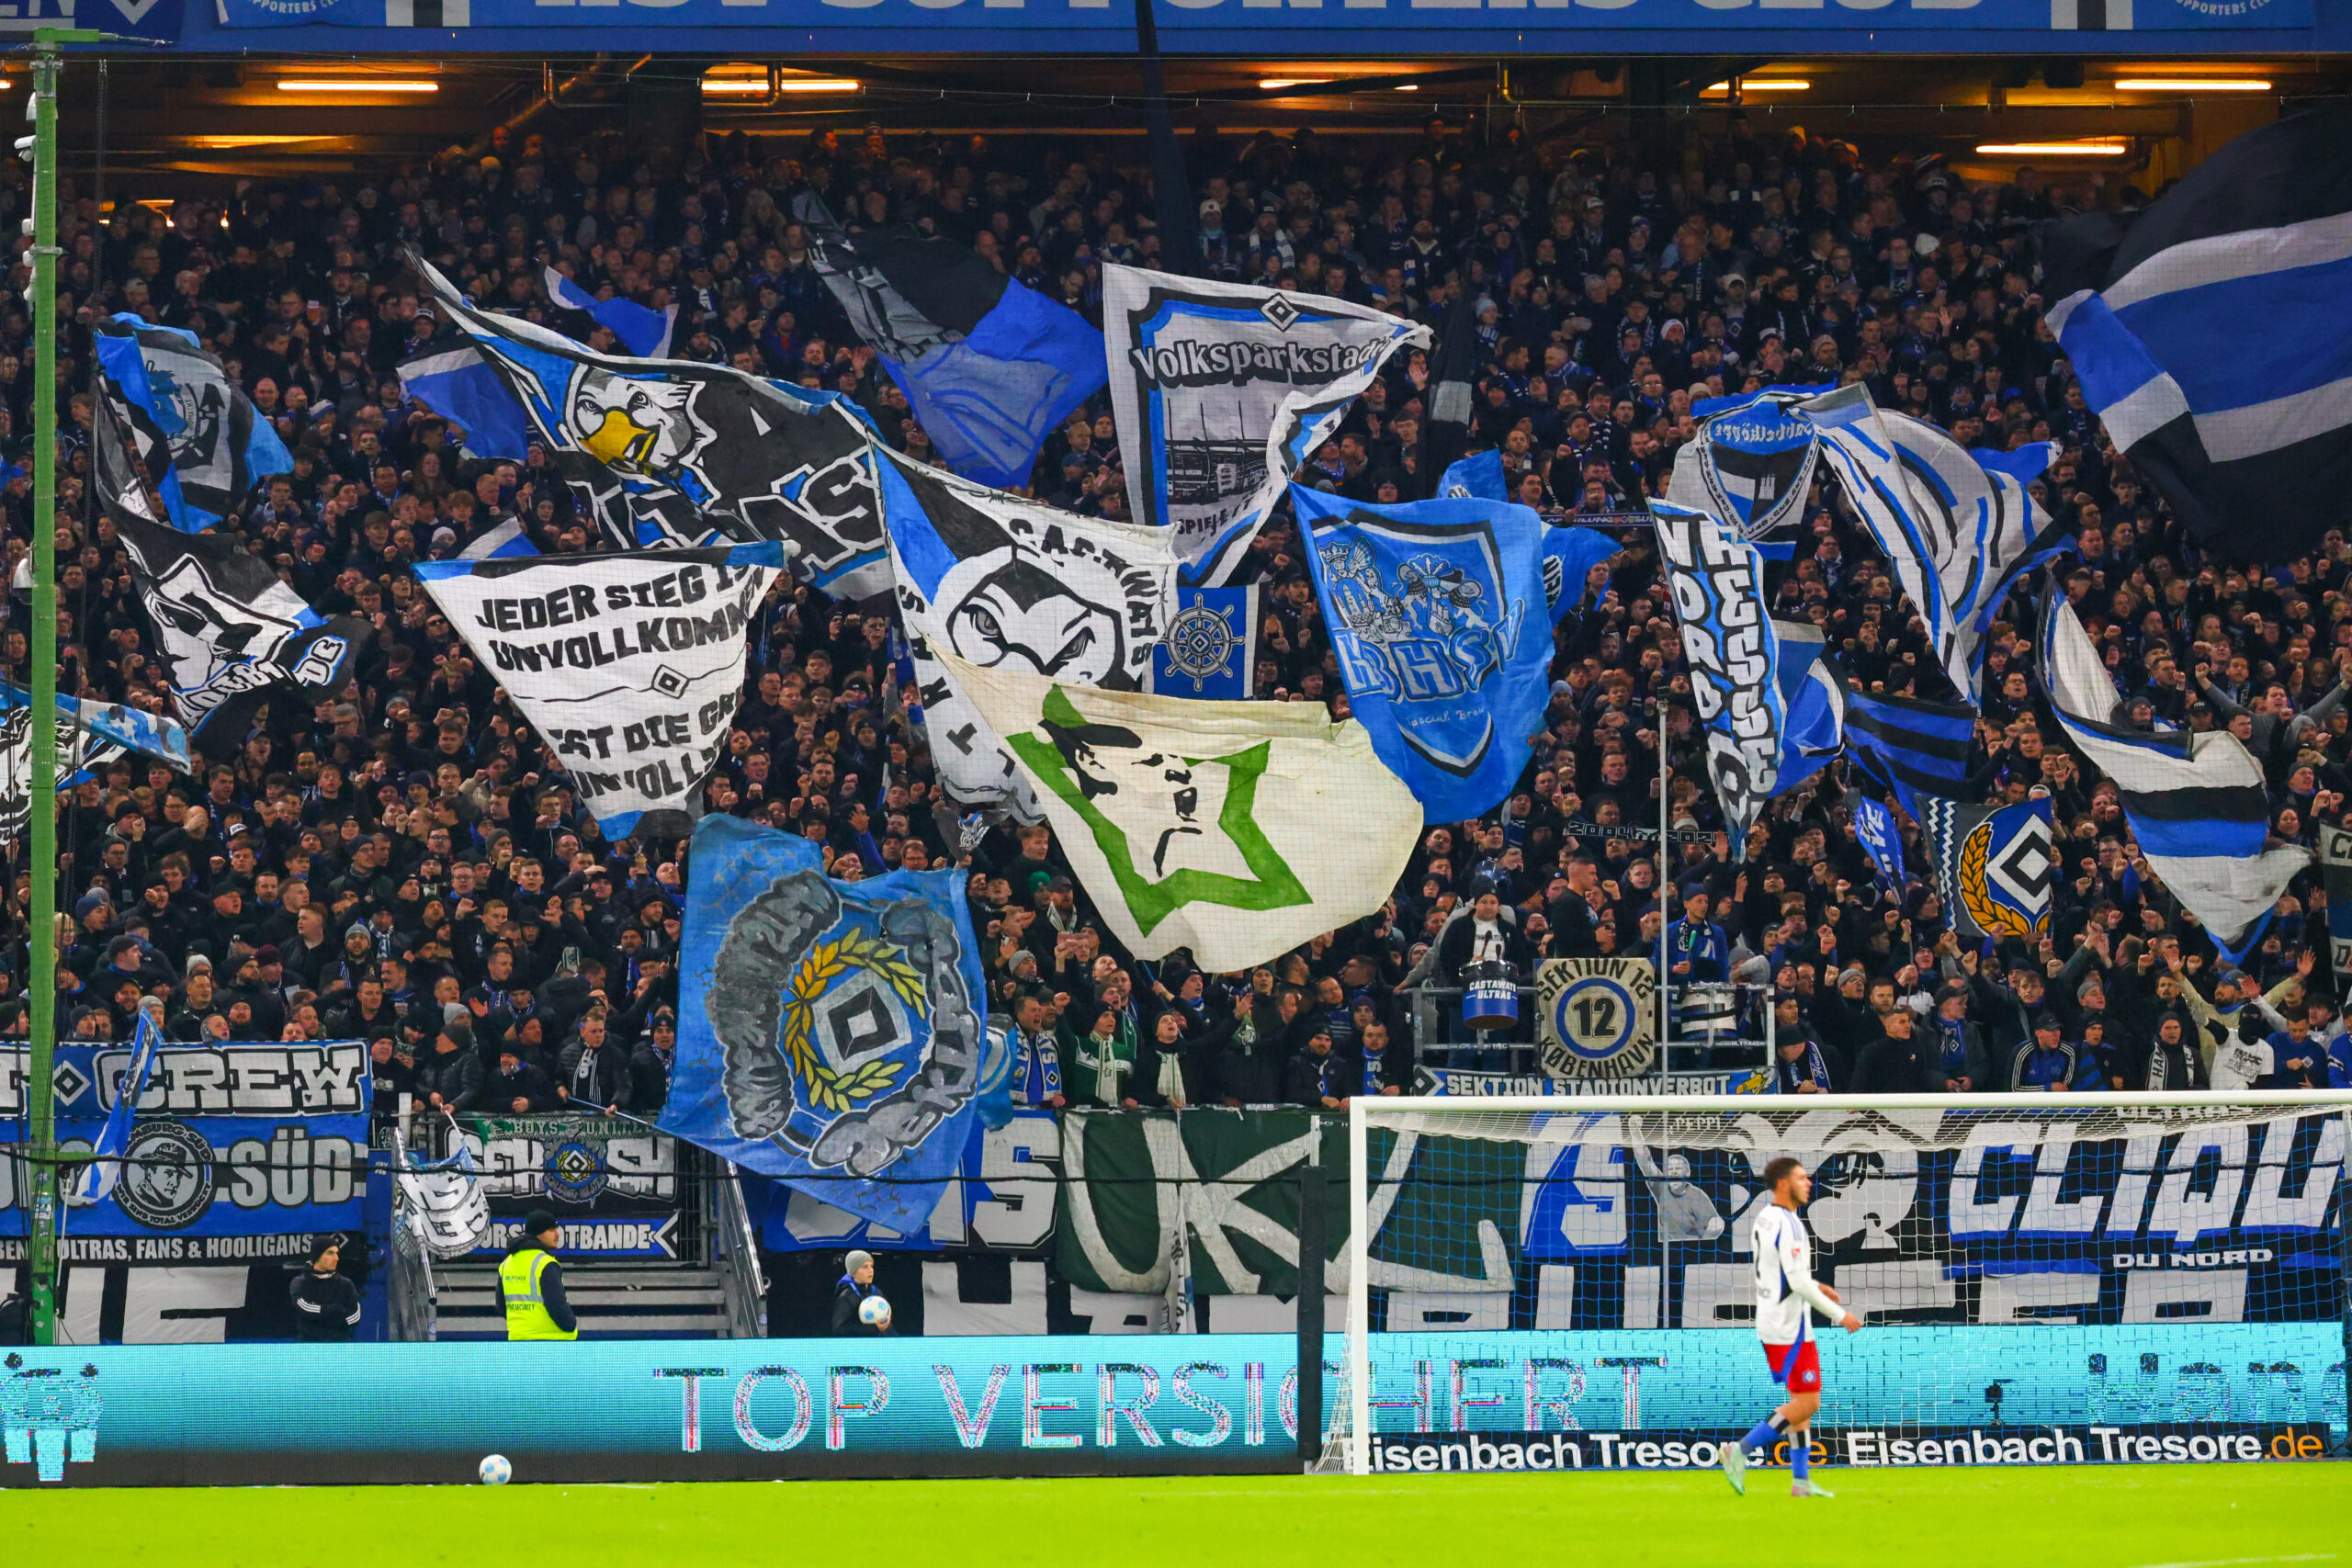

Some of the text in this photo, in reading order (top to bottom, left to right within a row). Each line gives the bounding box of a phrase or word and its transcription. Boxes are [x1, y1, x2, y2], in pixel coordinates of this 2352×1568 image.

[475, 584, 600, 632] JEDER
[605, 565, 707, 611] SIEG
[623, 713, 691, 753] DIE
[1477, 989, 1511, 1000] ULTRAS
[1537, 957, 1655, 1002] SEKTION 12
[1572, 997, 1617, 1039] 12
[1539, 1032, 1655, 1078] KØBENHAVN
[96, 1045, 363, 1113] CREW
[1445, 1073, 1733, 1096] SEKTION STADIONVERBOT
[513, 1120, 655, 1136] BOYS UNITE
[228, 1126, 356, 1210] SÜD
[149, 1215, 176, 1225] TOTAL
[136, 1237, 185, 1259] FANS
[188, 1240, 201, 1259] &
[206, 1233, 314, 1258] HOOLIGANS
[2113, 1248, 2274, 1269] DU NORD
[653, 1365, 891, 1452] TOP
[1590, 1433, 1828, 1469] Tresoe.de
[1847, 1426, 2324, 1465] Eisenbach Tresore.de
